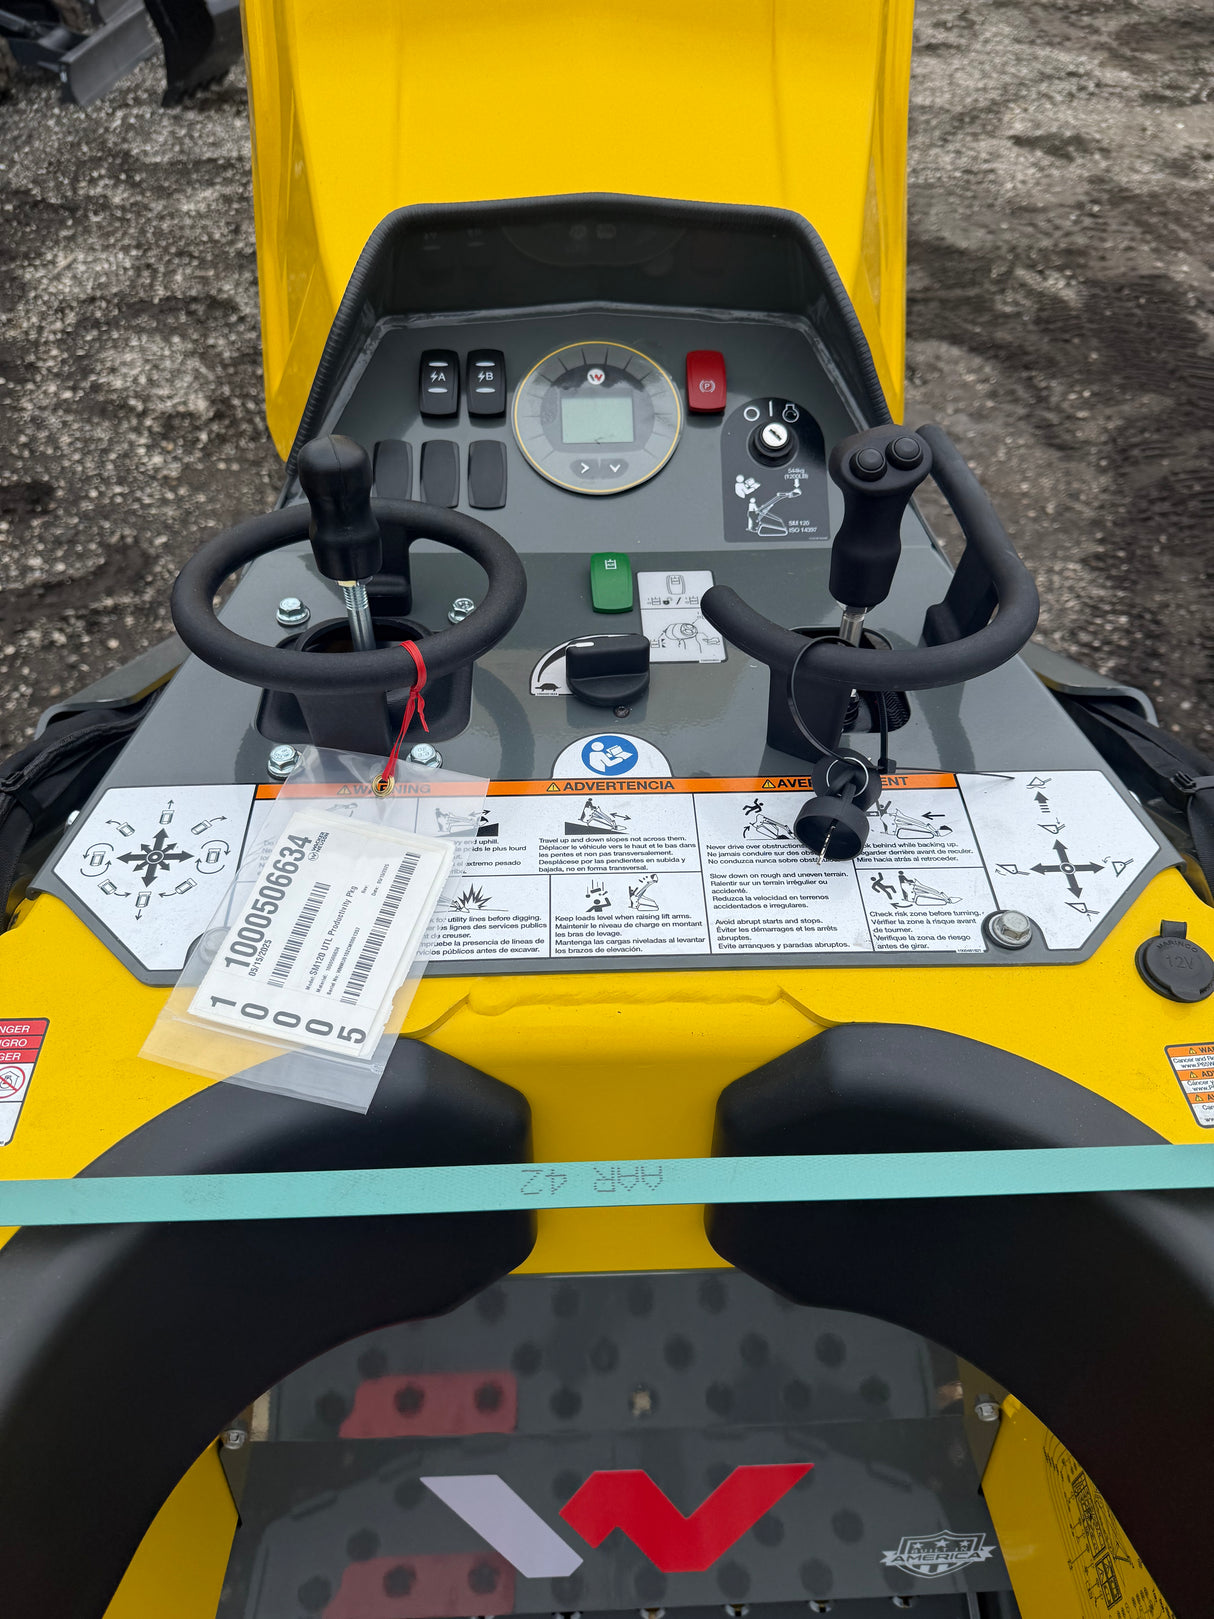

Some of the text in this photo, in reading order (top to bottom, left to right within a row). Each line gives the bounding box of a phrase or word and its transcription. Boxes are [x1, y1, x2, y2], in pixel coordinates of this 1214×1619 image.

[563, 781, 675, 791] ADVERTENCIA
[225, 834, 312, 968] 1000506634
[309, 951, 326, 976] SM120
[321, 936, 332, 950] UTL
[328, 898, 352, 935] Productivity
[346, 884, 357, 897] Pkg
[248, 939, 272, 976] 05/15/2025
[891, 1552, 982, 1562] AMERICA
